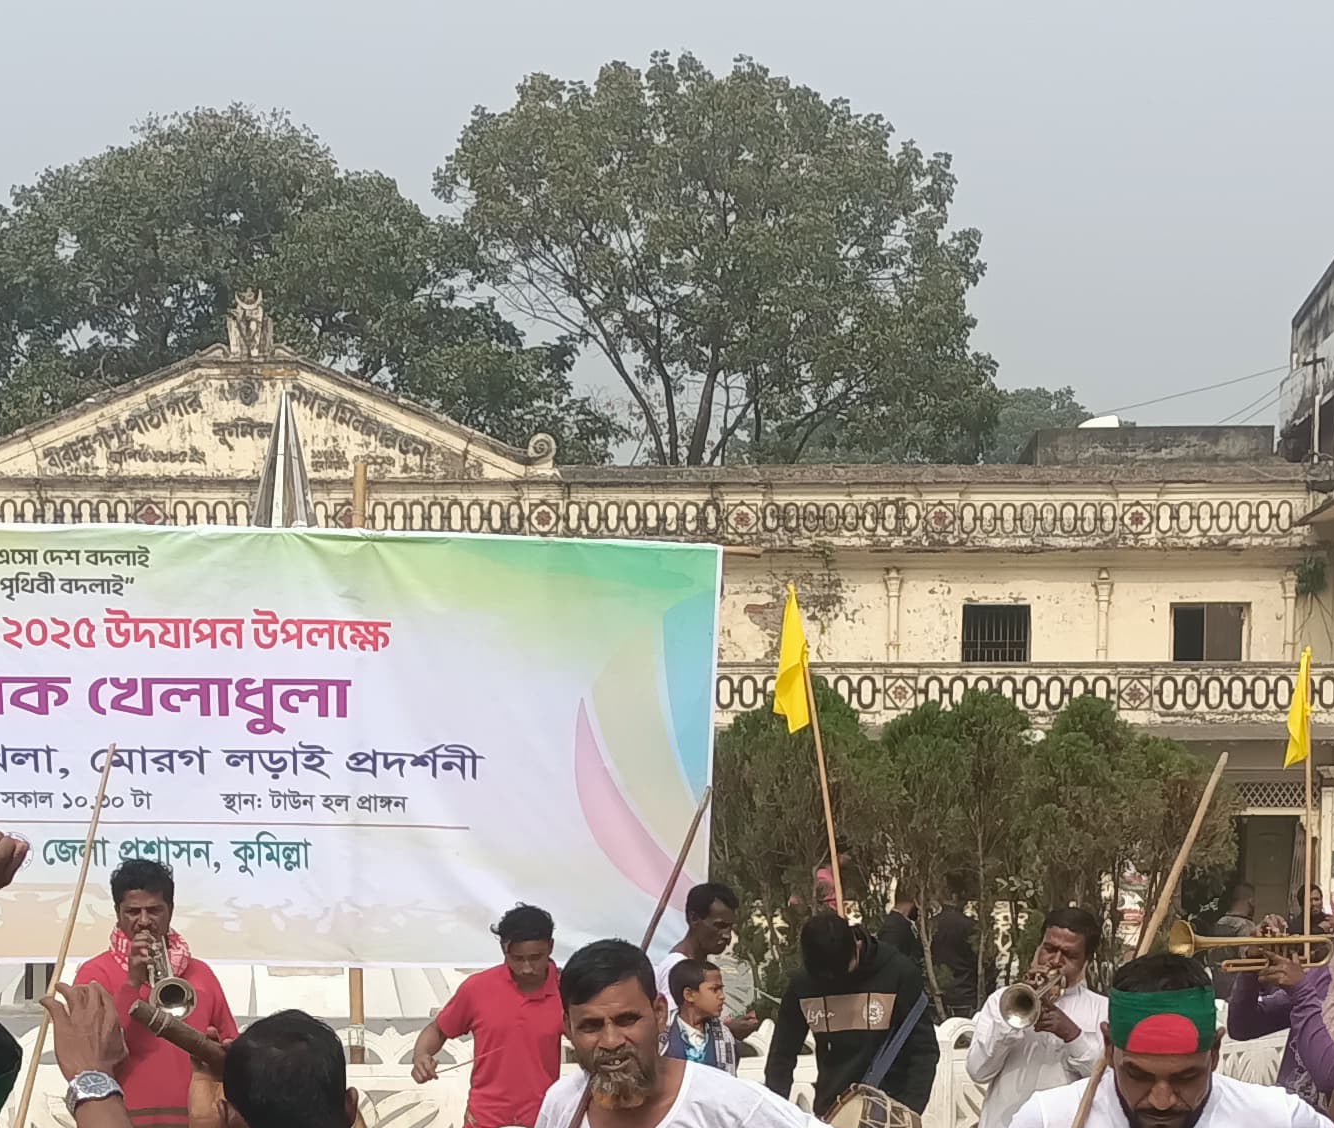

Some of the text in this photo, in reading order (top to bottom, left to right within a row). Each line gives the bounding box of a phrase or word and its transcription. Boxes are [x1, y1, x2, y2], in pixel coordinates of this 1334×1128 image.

[43, 549, 80, 566] দেশ
[85, 545, 151, 568] বদলাই
[0, 572, 55, 602] পৃথিবী
[2, 616, 96, 650] ২০২৫
[103, 607, 245, 650] উদযাপন
[250, 608, 392, 652] উপলক্ষে
[88, 676, 353, 736] খেলাধুলা
[90, 744, 212, 776] মোরগ
[221, 740, 334, 780] লড়াই
[345, 743, 486, 781] প্রদর্শনী
[0, 789, 55, 809] সকাল
[130, 786, 153, 811] টা
[219, 791, 263, 815] স্থান:
[268, 788, 316, 812] টাউন
[319, 793, 352, 814] হল
[42, 835, 110, 867] জেলা
[230, 830, 312, 877] কুমিল্লা
